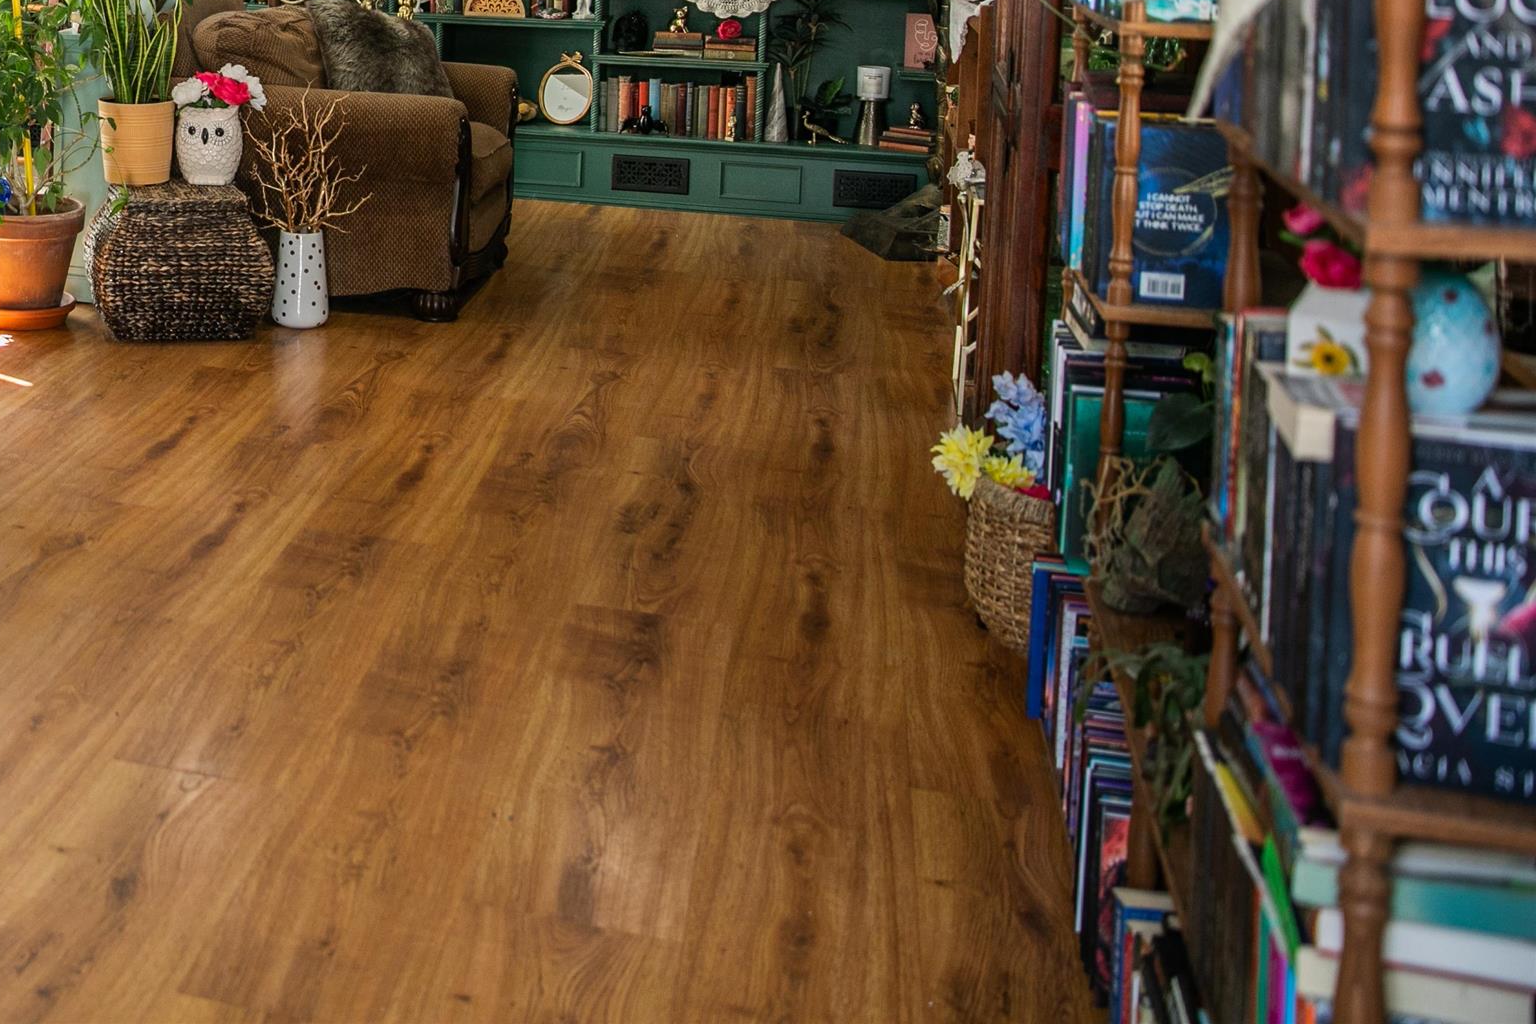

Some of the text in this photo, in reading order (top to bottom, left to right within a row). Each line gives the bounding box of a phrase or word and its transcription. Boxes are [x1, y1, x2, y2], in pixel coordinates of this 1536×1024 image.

[1465, 29, 1532, 60] AND
[1151, 192, 1190, 203] CANNOT
[1139, 201, 1164, 211] STOP
[1156, 211, 1177, 220] CAN
[1178, 212, 1204, 223] MAKE
